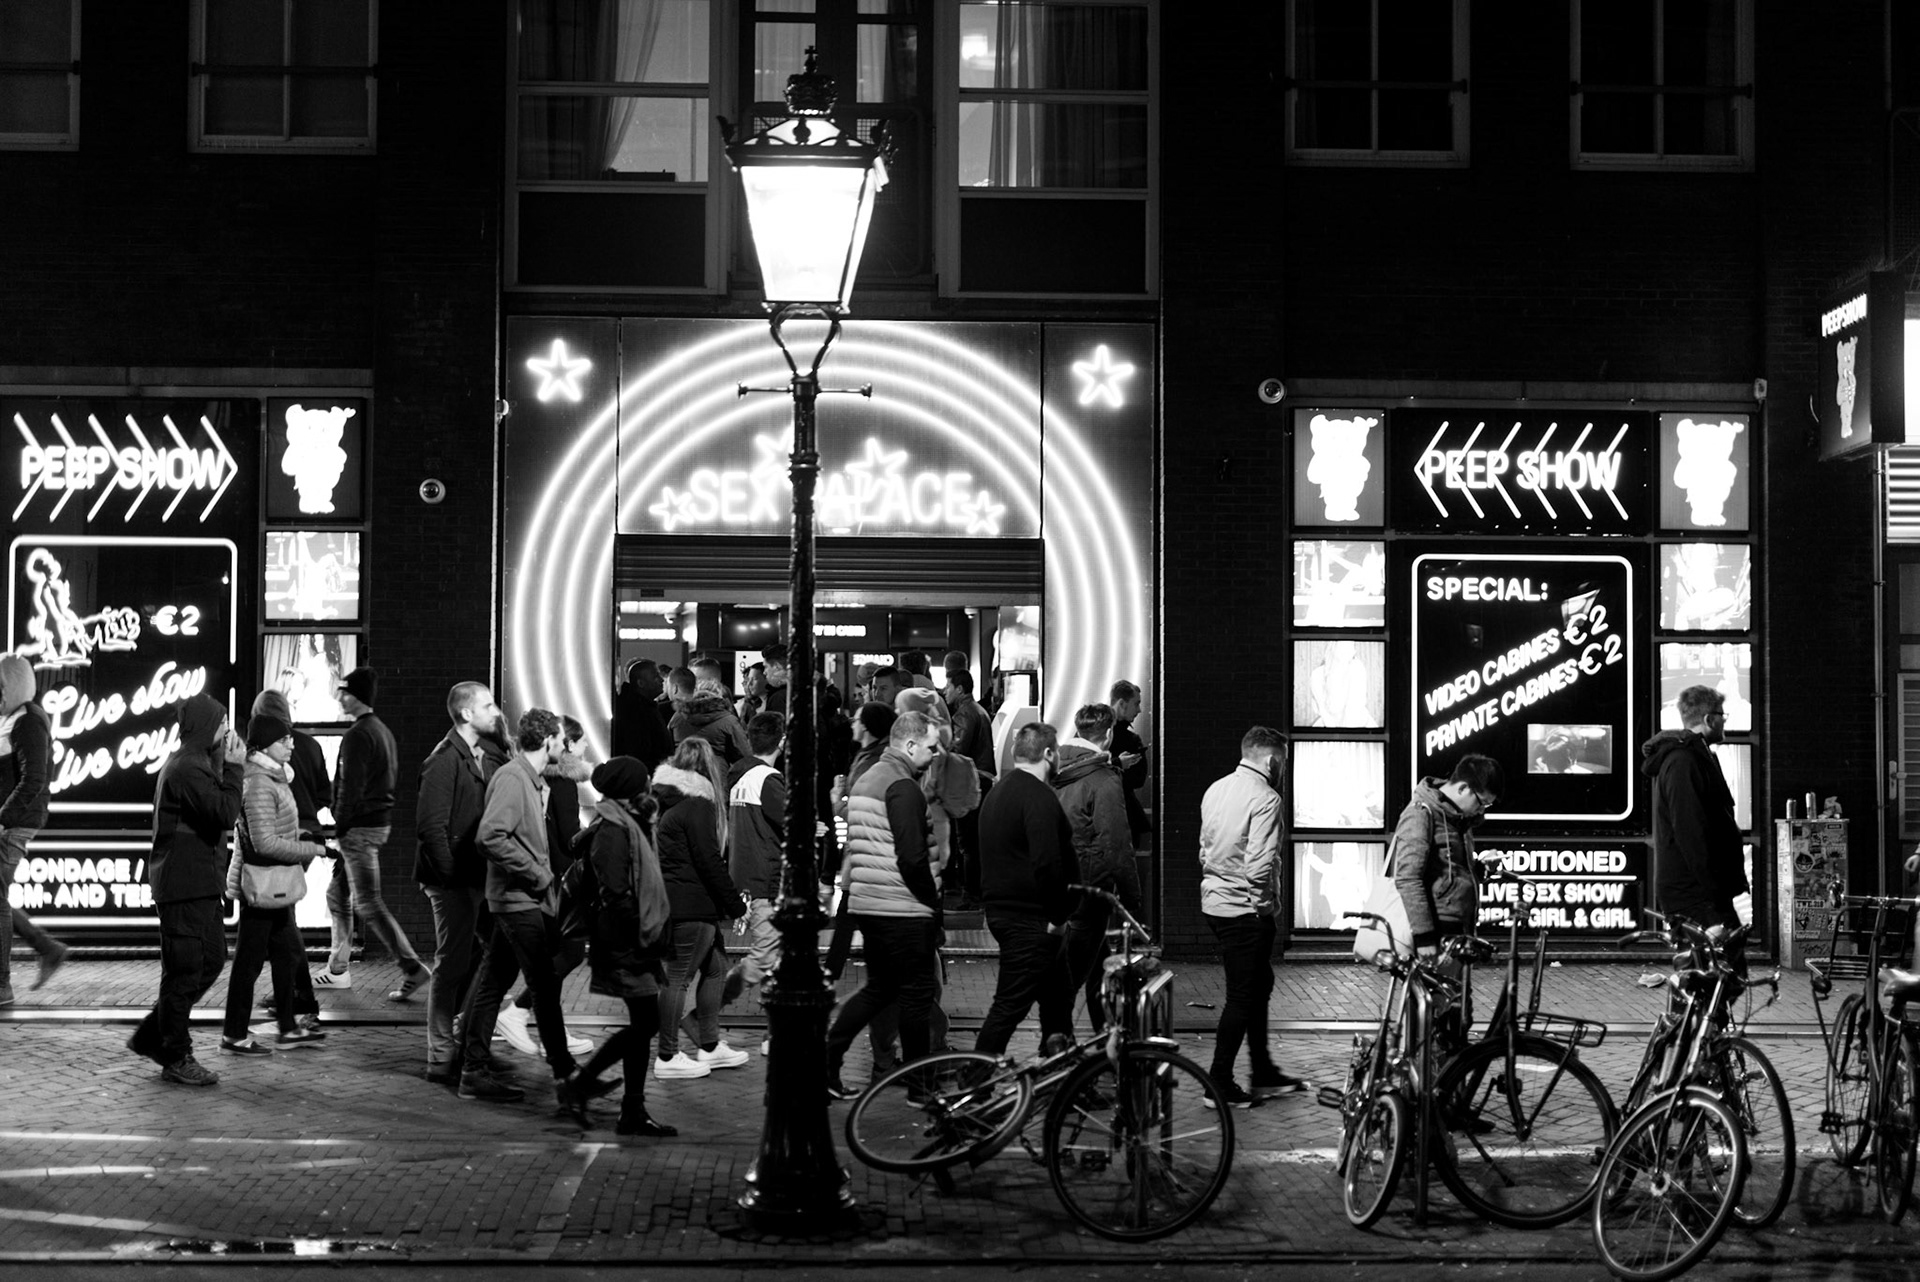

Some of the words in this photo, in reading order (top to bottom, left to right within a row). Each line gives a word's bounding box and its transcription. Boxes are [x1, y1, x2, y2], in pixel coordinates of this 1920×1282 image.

[1822, 293, 1867, 338] PEEPSHOW
[21, 446, 110, 490] PEEP
[118, 447, 225, 490] SHOW
[1424, 450, 1509, 488] PEEP
[1516, 450, 1622, 490] SHOW
[689, 469, 780, 522] SEX
[815, 472, 974, 524] ALACE
[1427, 576, 1548, 602] SPECIAL:
[1425, 669, 1481, 716] VIDEO
[1482, 628, 1561, 686] CABINES
[42, 686, 127, 739] Live
[130, 661, 206, 715] show
[1425, 698, 1499, 757] PRIVATE
[1501, 658, 1579, 716] CABINES
[1473, 849, 1627, 873] NDITIONED
[54, 884, 106, 908] AND
[1478, 883, 1520, 903] LIVE
[1523, 883, 1561, 903] SEX
[1564, 883, 1624, 904] SHOW
[1527, 908, 1573, 928] GIRL
[1573, 908, 1589, 928] &
[1590, 908, 1637, 928] GIRL
